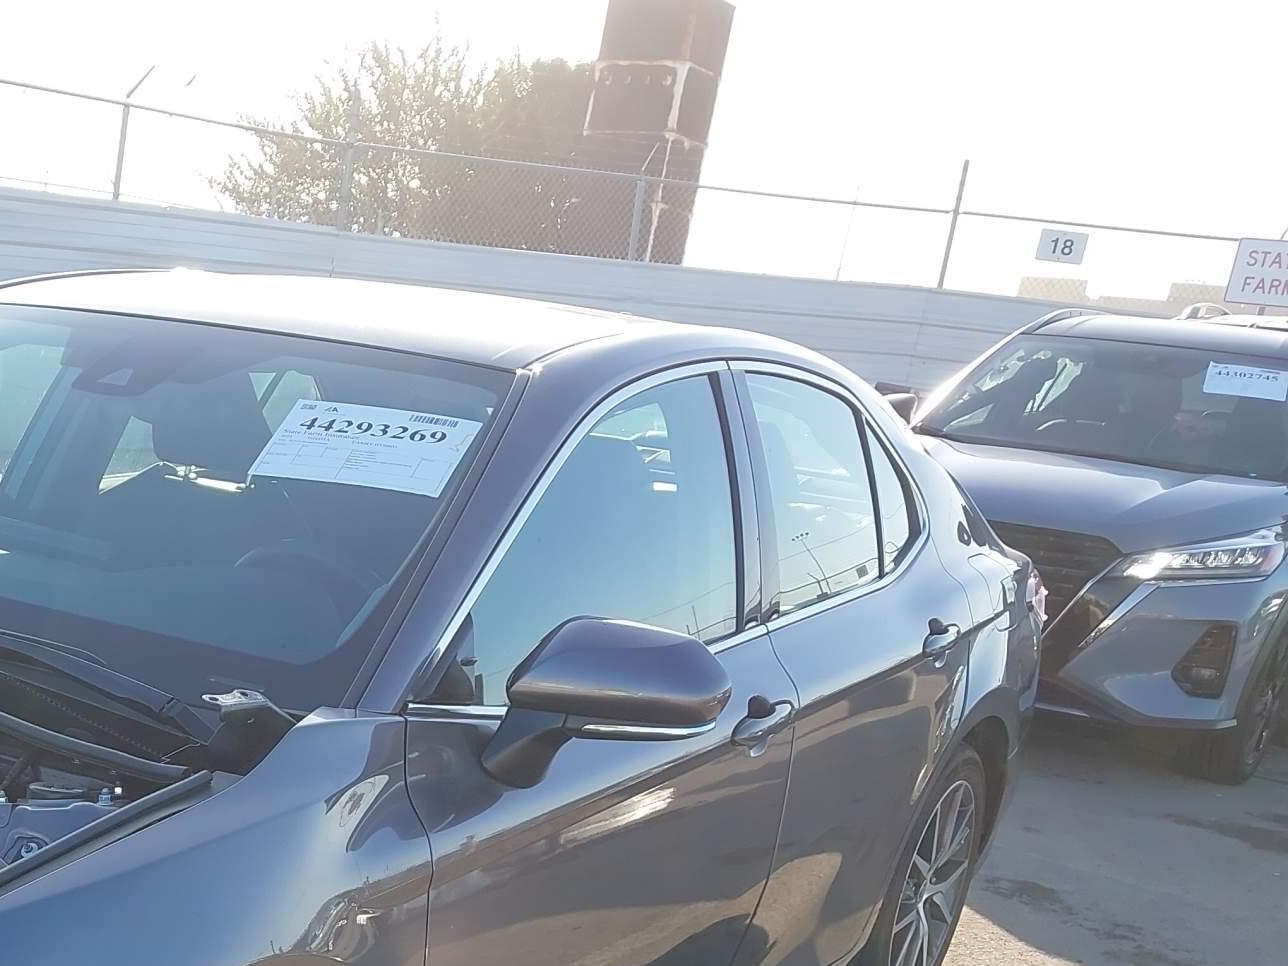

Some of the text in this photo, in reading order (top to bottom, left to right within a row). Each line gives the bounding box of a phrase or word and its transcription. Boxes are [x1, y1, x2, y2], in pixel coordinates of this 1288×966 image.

[1051, 237, 1074, 256] 18
[1246, 250, 1288, 269] STA
[300, 417, 448, 444] 44293269
